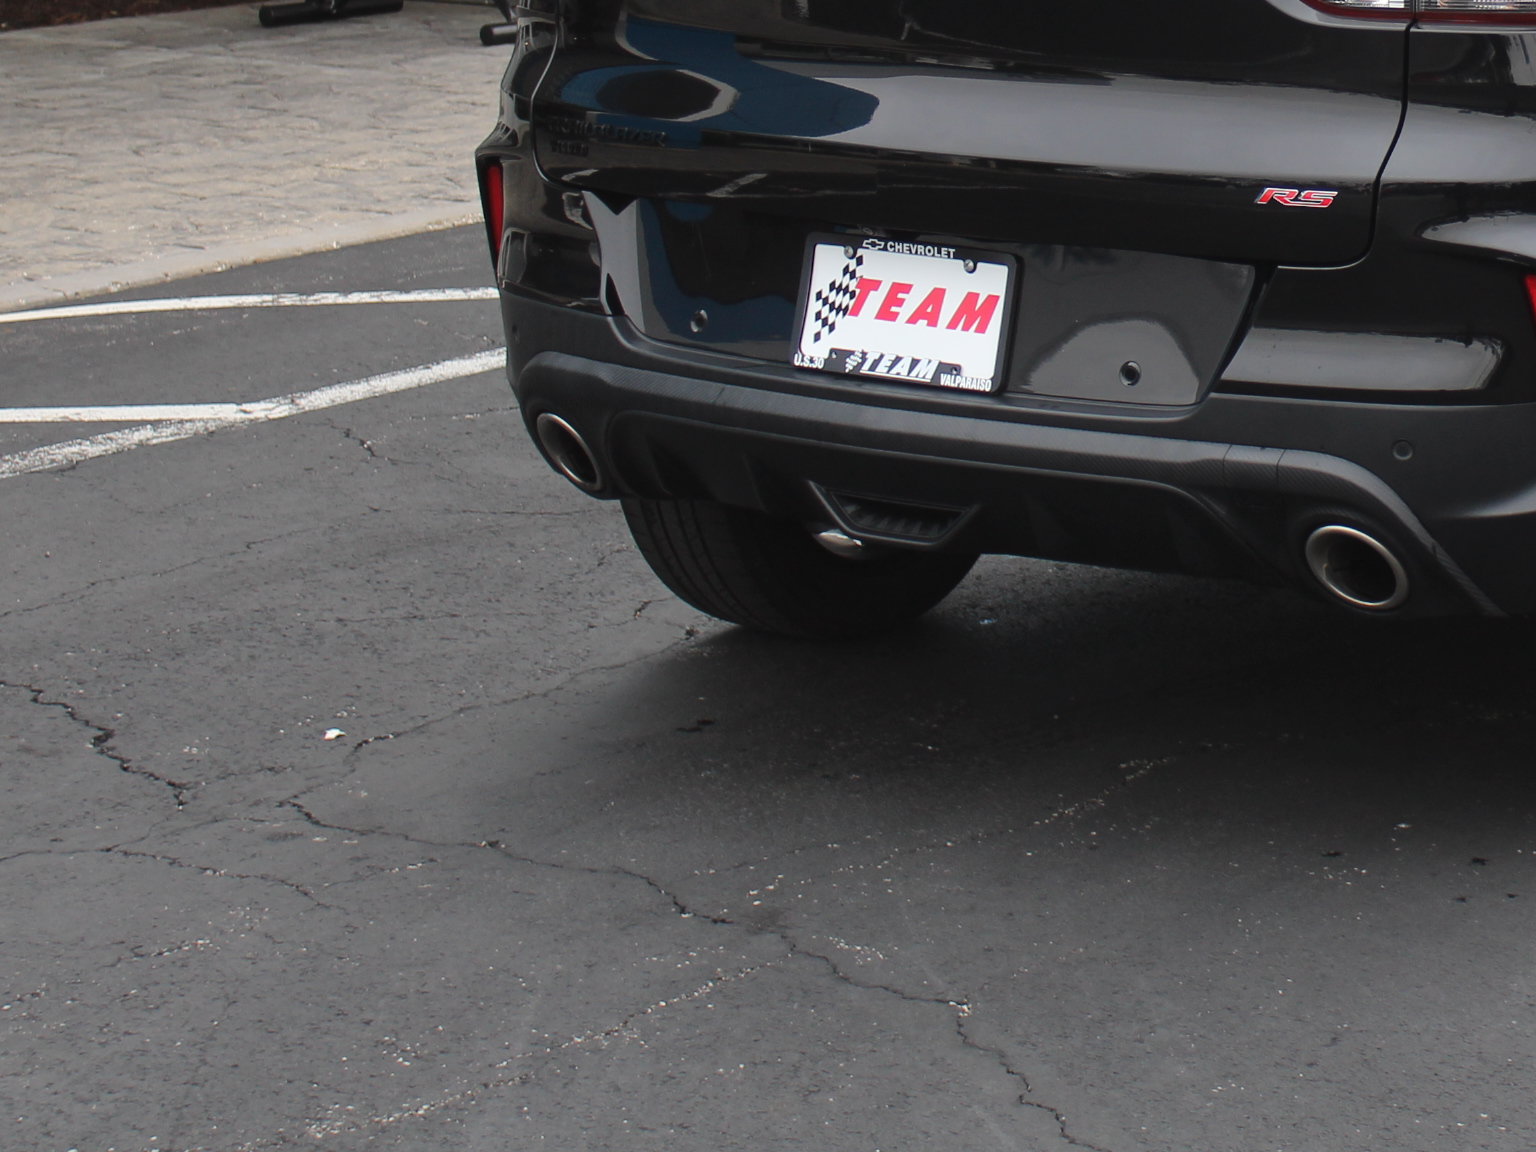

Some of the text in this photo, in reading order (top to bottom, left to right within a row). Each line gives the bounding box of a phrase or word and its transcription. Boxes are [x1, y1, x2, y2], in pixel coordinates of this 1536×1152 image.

[1254, 187, 1339, 209] RS
[886, 240, 956, 259] CHEVROLET
[847, 276, 1000, 335] TEAM
[859, 350, 941, 381] TEAM
[939, 373, 992, 393] VALPARAISO
